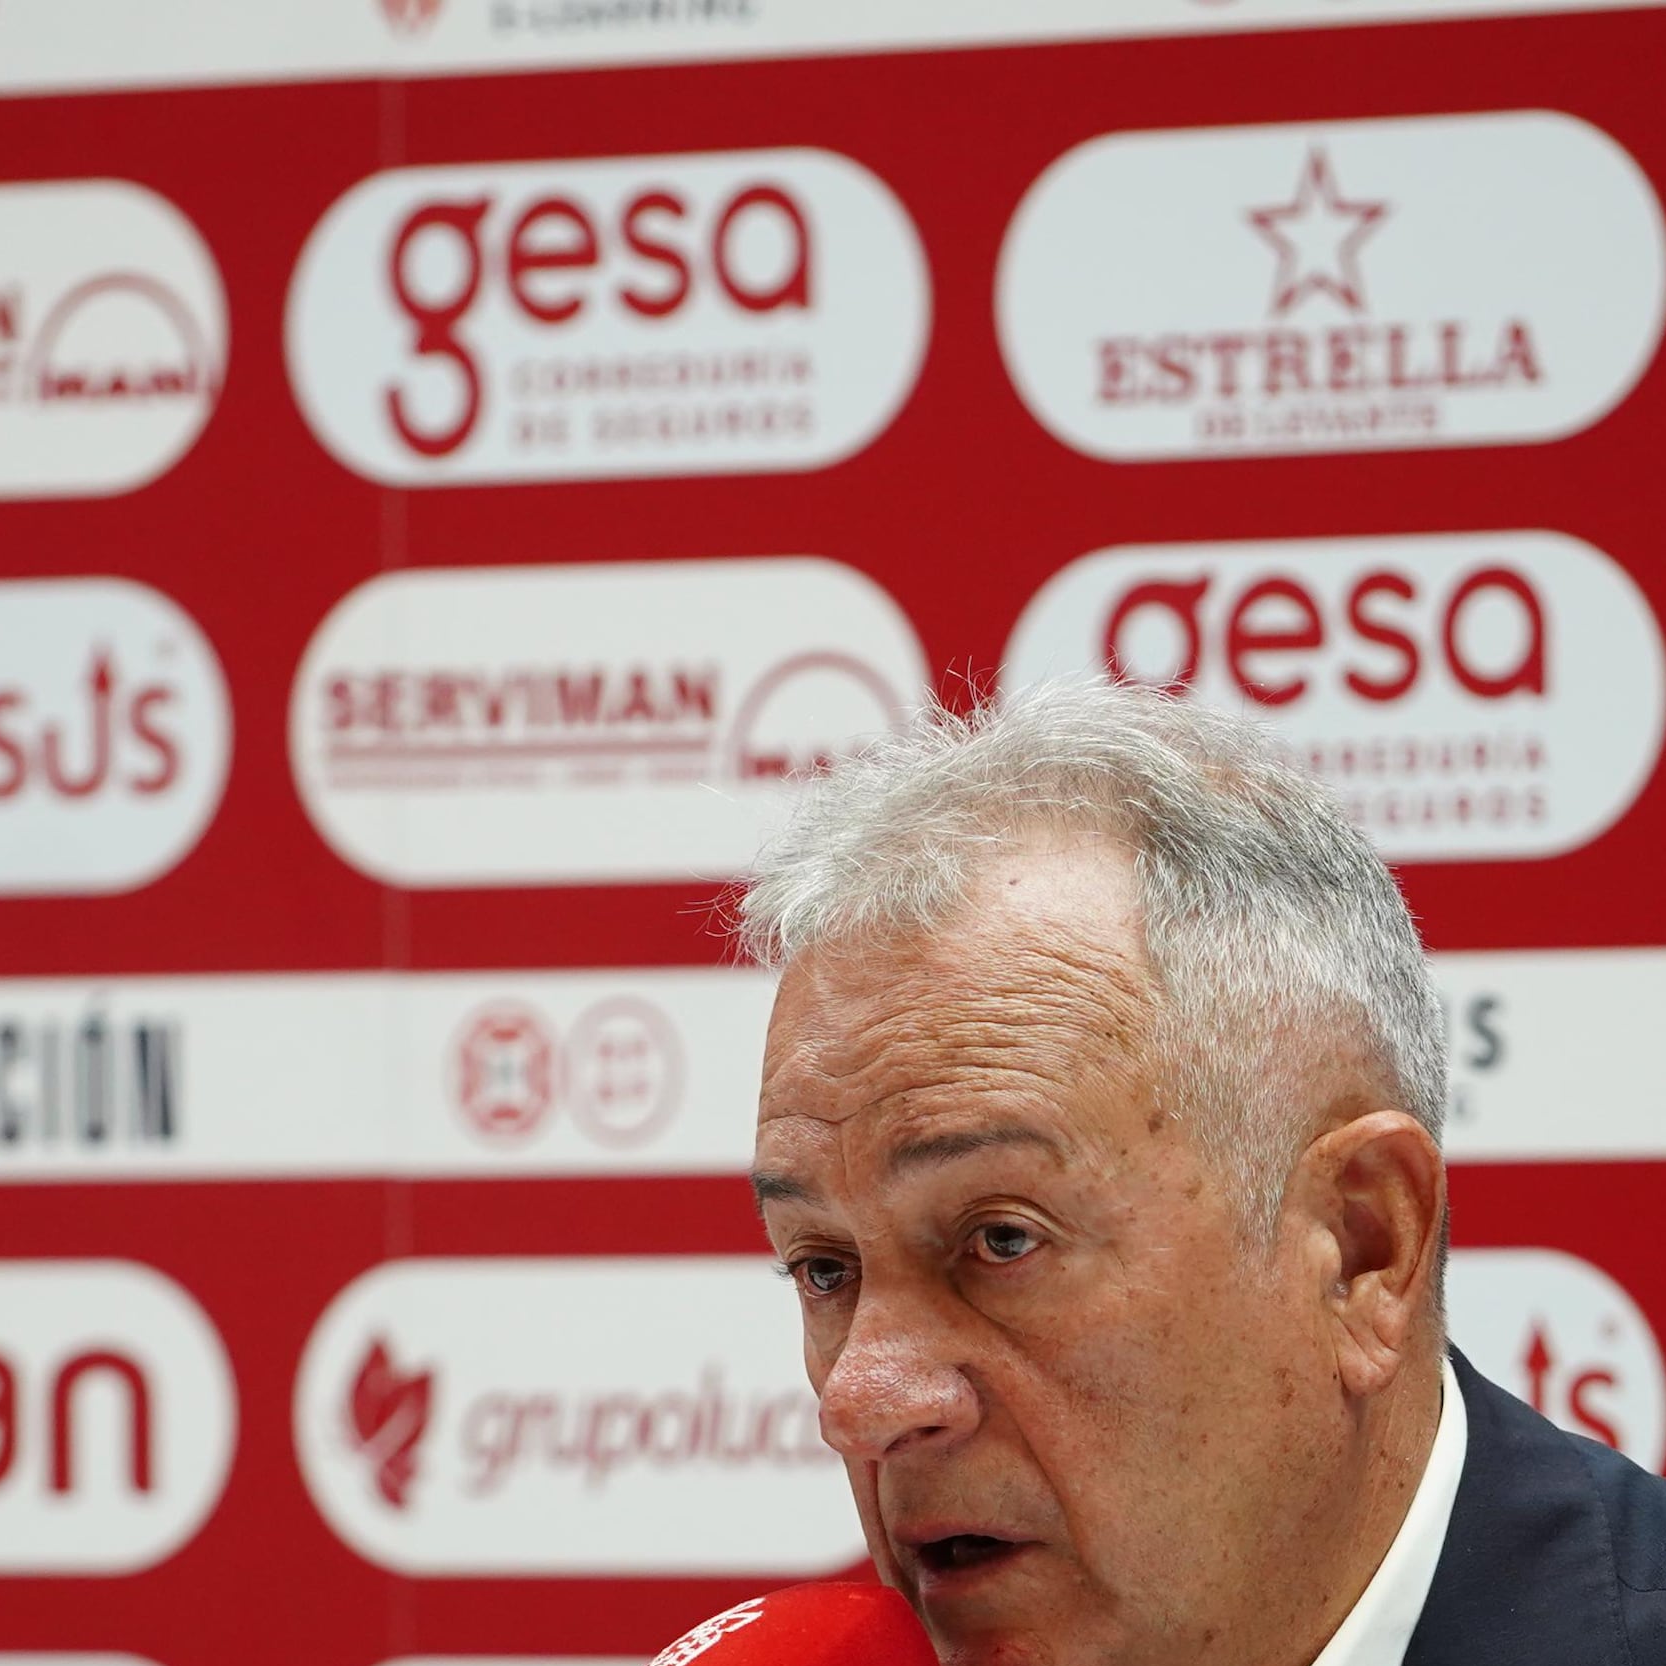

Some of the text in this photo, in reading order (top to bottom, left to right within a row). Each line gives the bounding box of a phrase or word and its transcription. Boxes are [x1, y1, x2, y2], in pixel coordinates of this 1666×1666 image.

[385, 178, 817, 460] gesa
[1095, 316, 1545, 406] ESTRELLA
[323, 662, 721, 734] SERVIMAN
